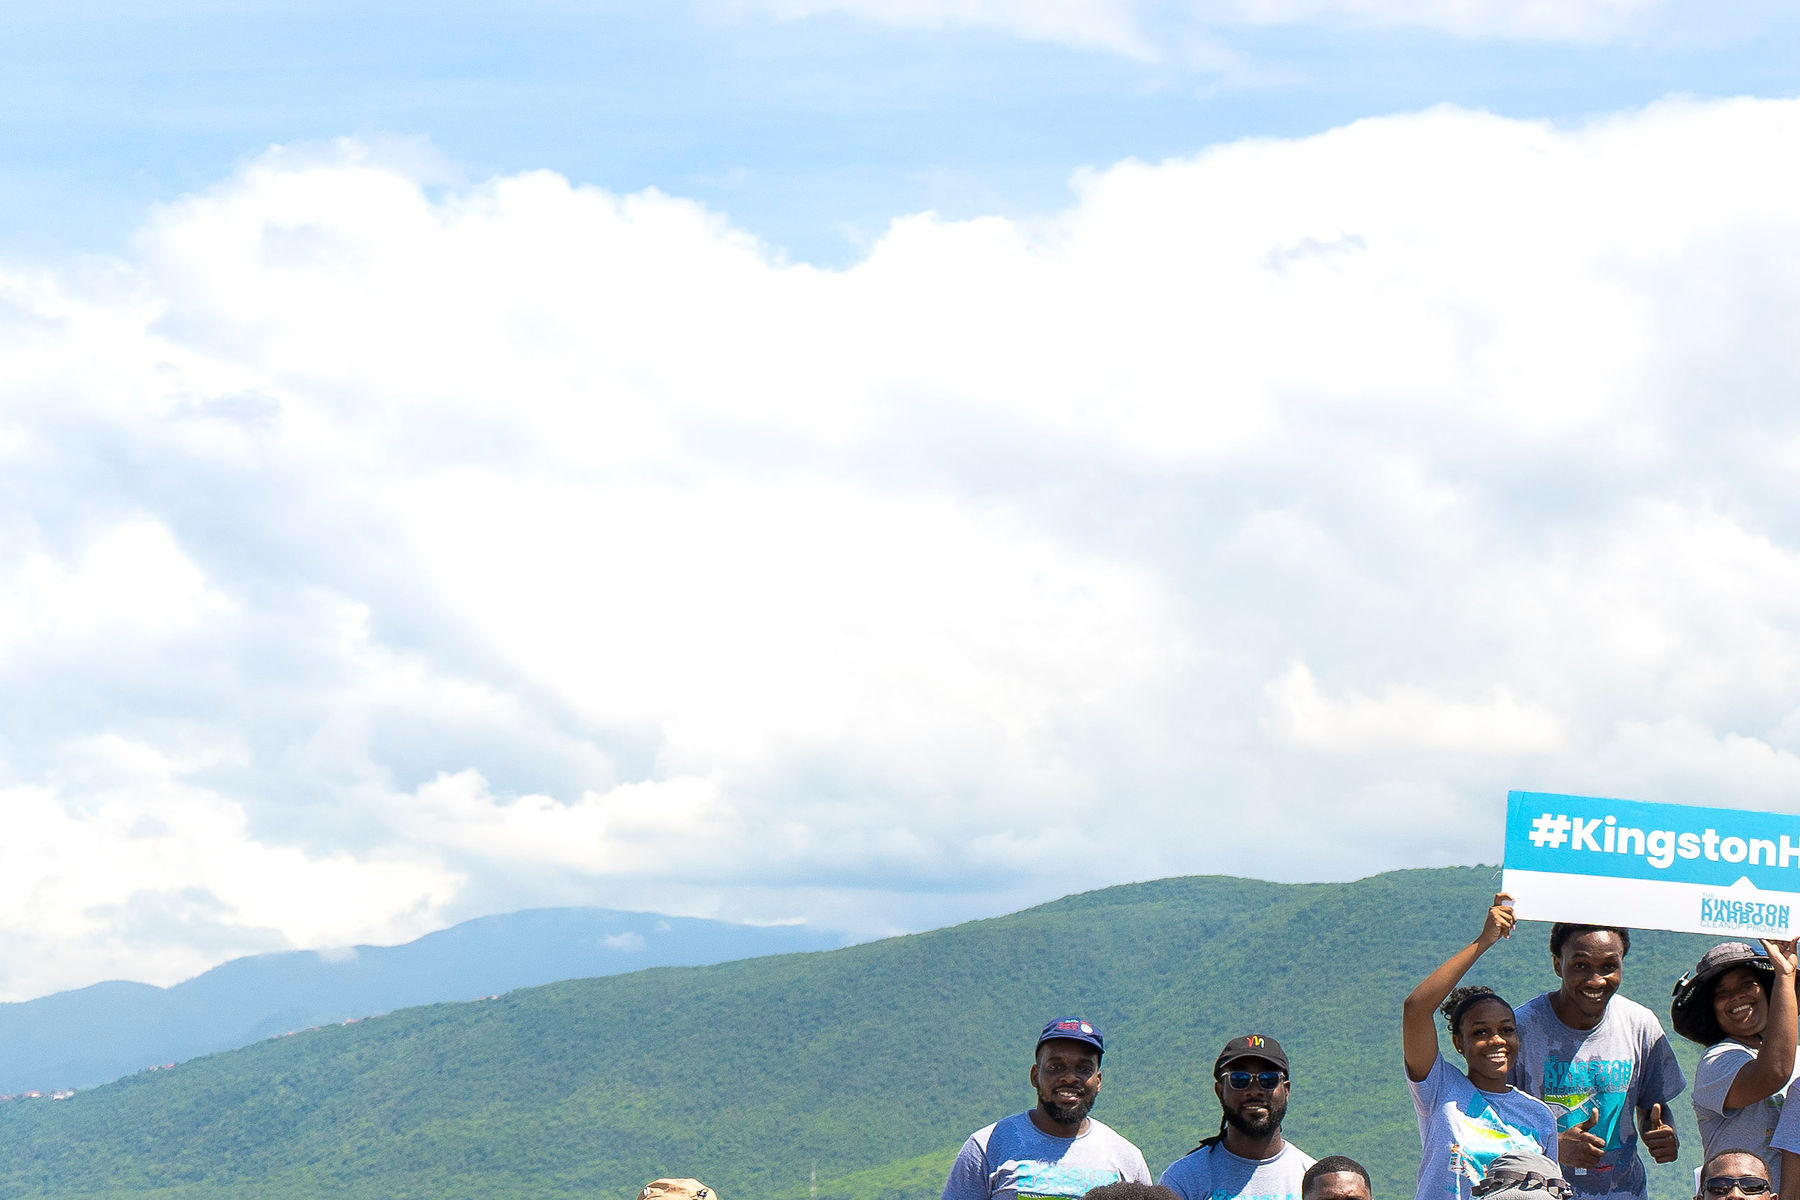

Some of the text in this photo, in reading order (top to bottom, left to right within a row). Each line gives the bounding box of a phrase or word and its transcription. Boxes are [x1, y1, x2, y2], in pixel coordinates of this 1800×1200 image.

[1702, 898, 1790, 916] KINGSTON
[1701, 909, 1789, 928] HARBOUR
[1701, 920, 1789, 934] CLEANUP PROJECT
